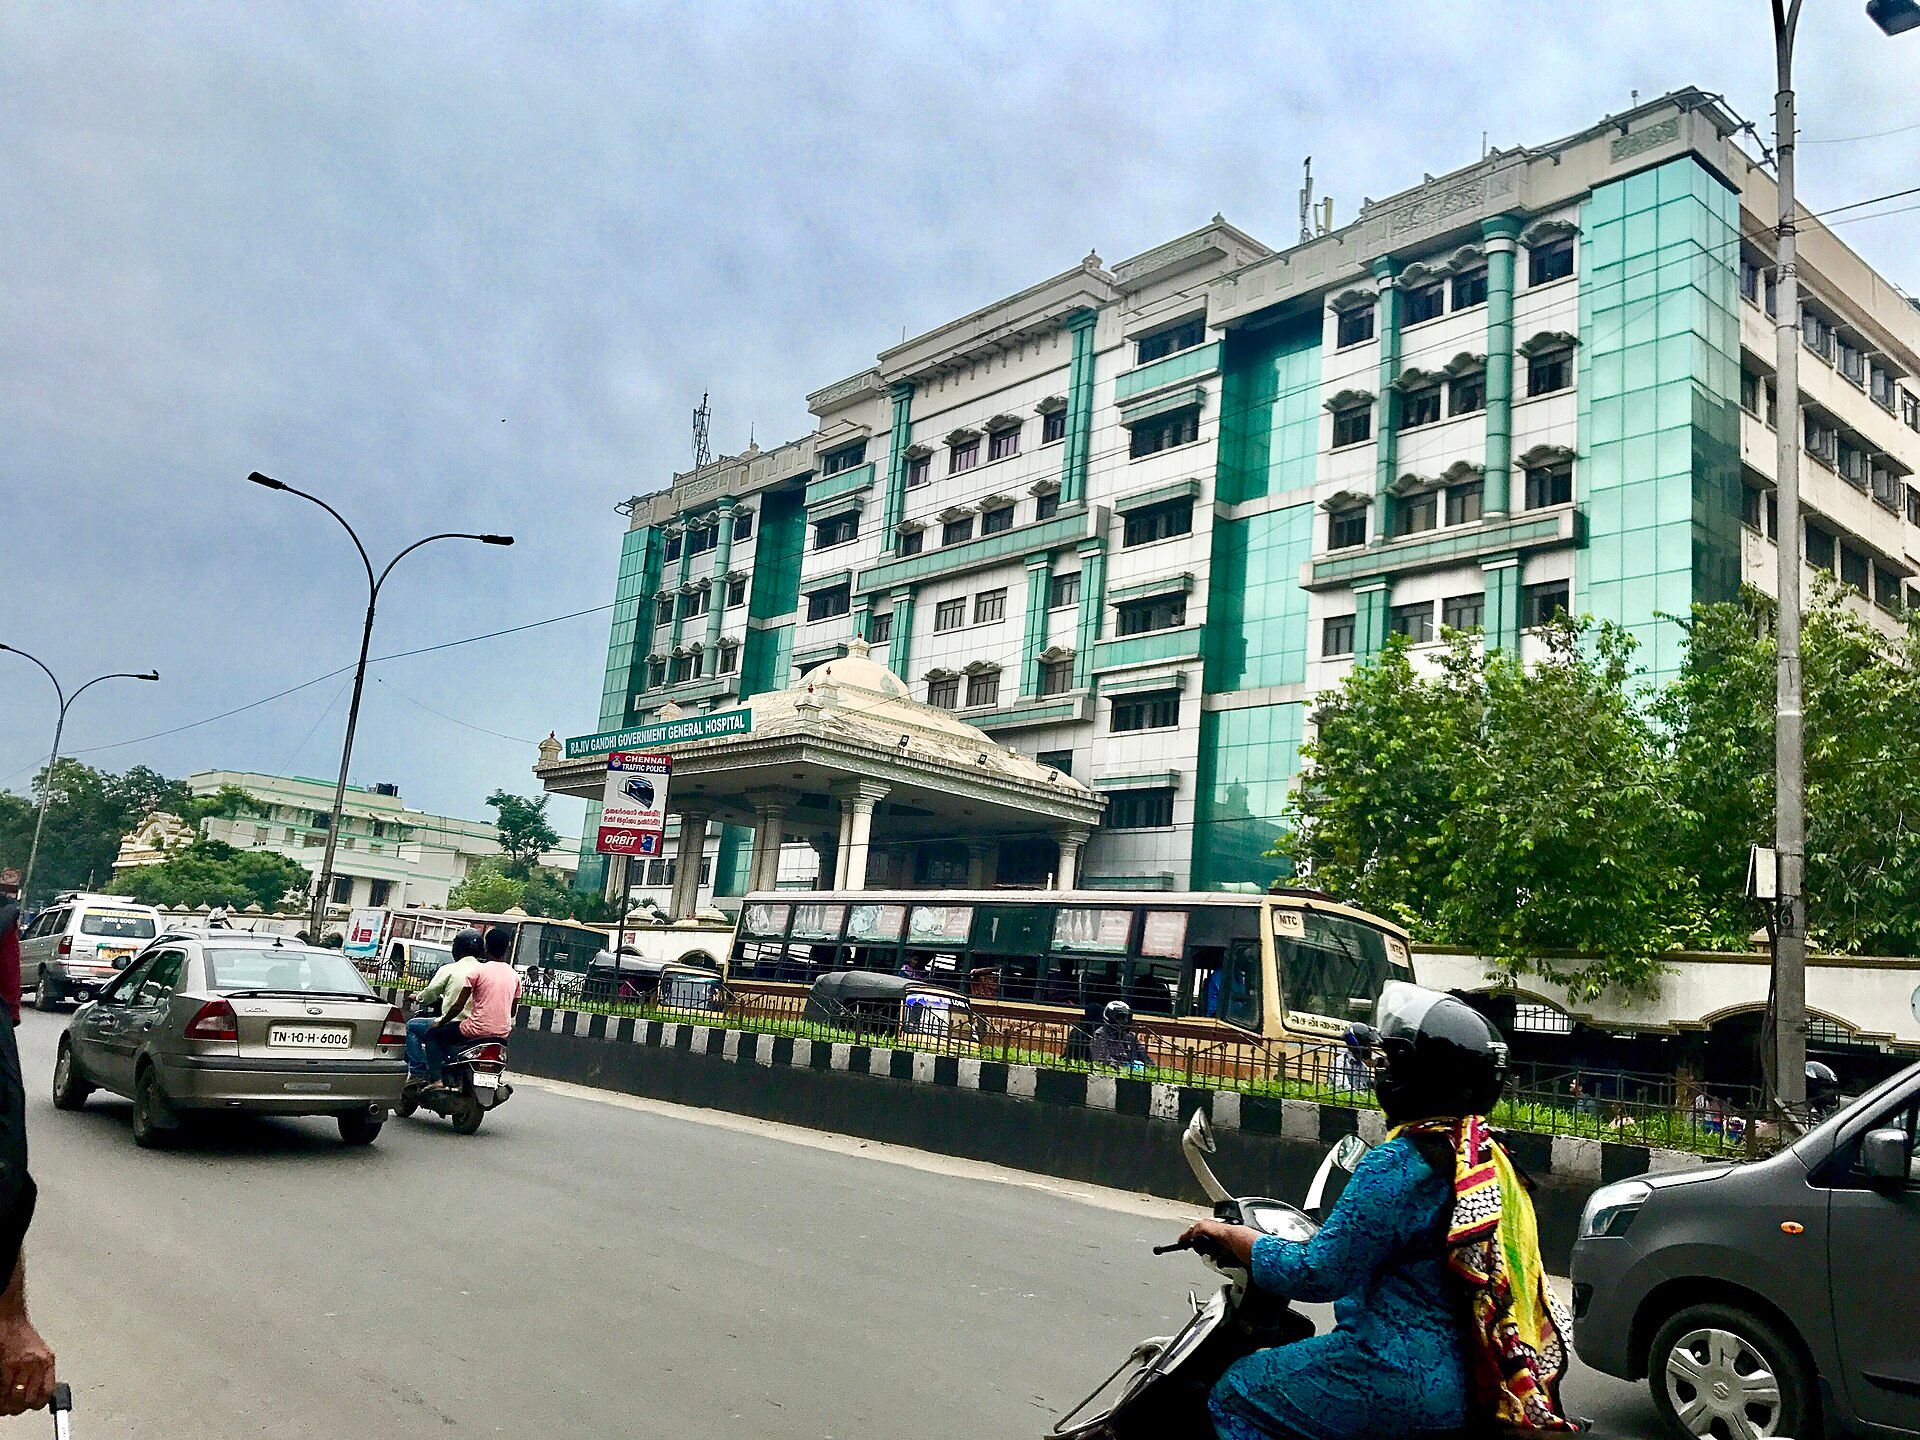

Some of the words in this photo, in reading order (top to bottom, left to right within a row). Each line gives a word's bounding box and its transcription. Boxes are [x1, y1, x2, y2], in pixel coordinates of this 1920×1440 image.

[570, 741, 590, 754] RAJIV
[591, 735, 617, 750] GANDHI
[617, 727, 667, 746] GOVERNMENT
[668, 722, 704, 740] GENERAL
[705, 715, 746, 734] HOSPITAL
[625, 755, 666, 764] CHENNAI
[622, 763, 645, 771] TRAFFIC
[645, 765, 667, 773] POLICE
[604, 834, 637, 846] ORBIT
[1279, 914, 1298, 926] MTC
